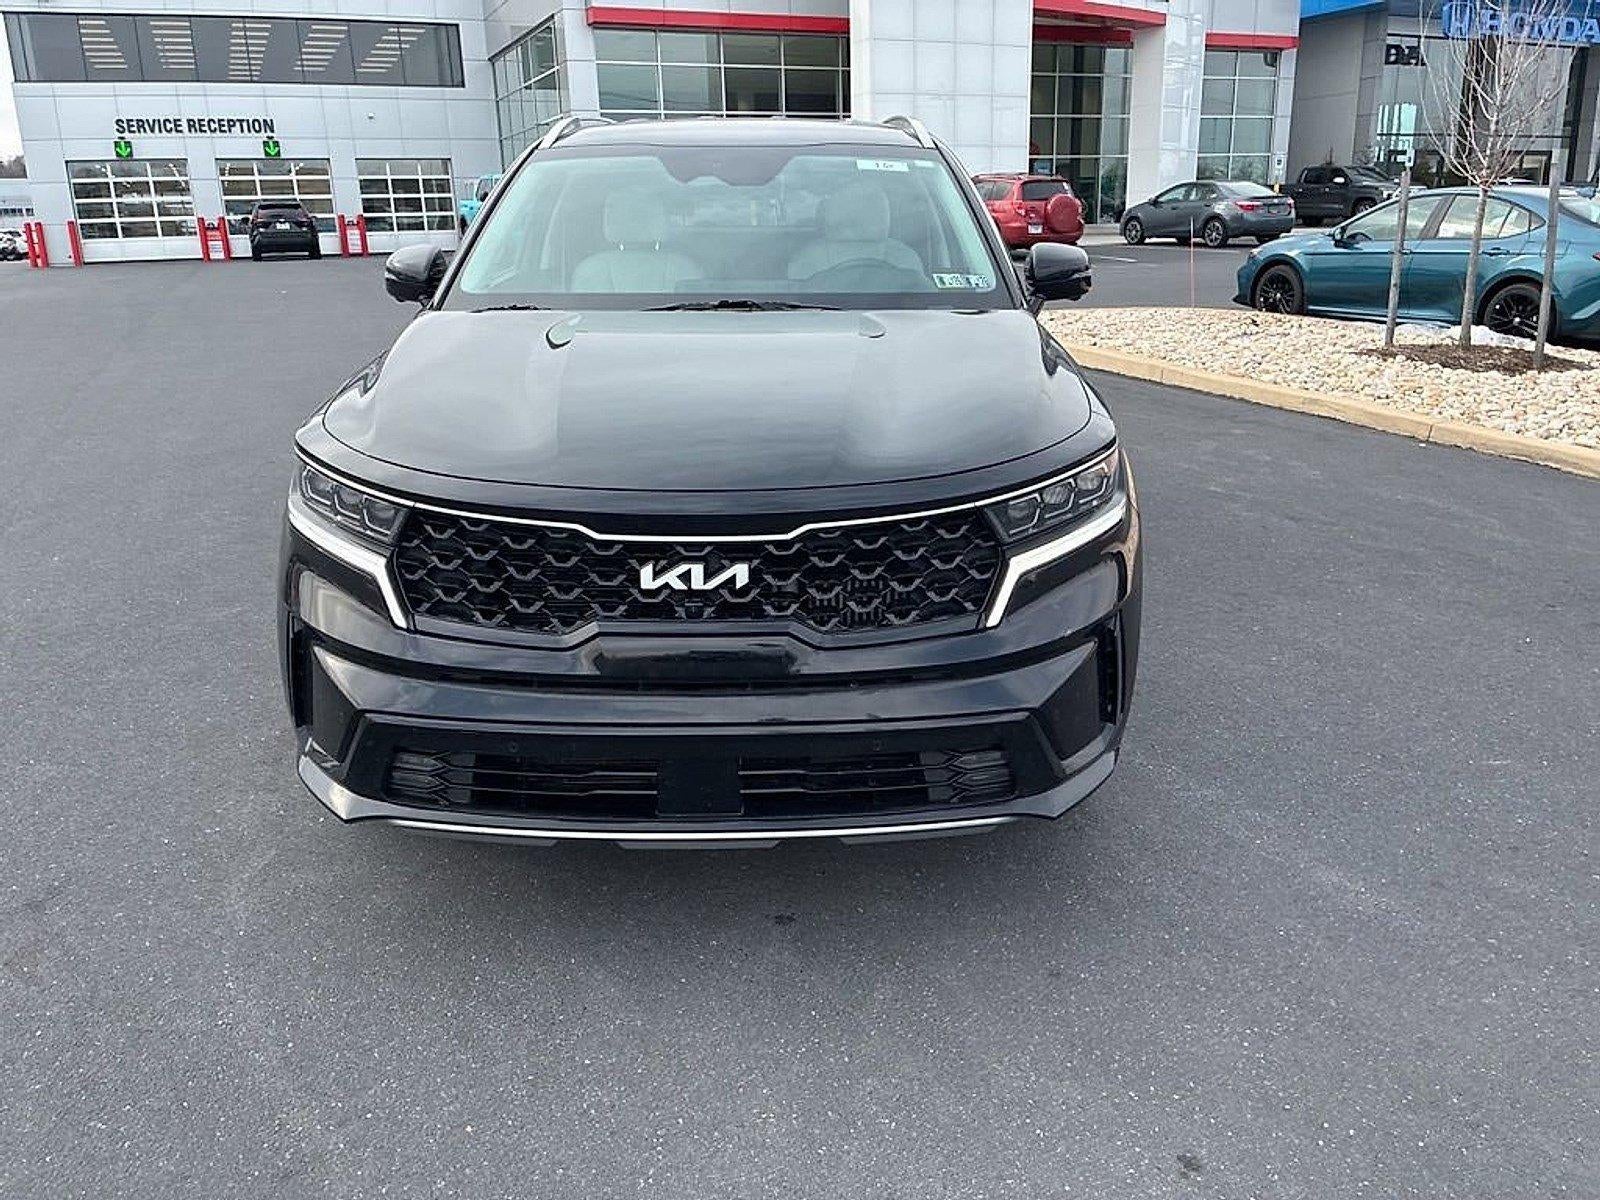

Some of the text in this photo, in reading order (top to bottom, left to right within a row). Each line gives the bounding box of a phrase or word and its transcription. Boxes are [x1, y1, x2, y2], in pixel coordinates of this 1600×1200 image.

[1480, 9, 1600, 43] HONDA
[115, 118, 275, 134] SERVICE RECEPTION
[640, 563, 750, 590] KIA
